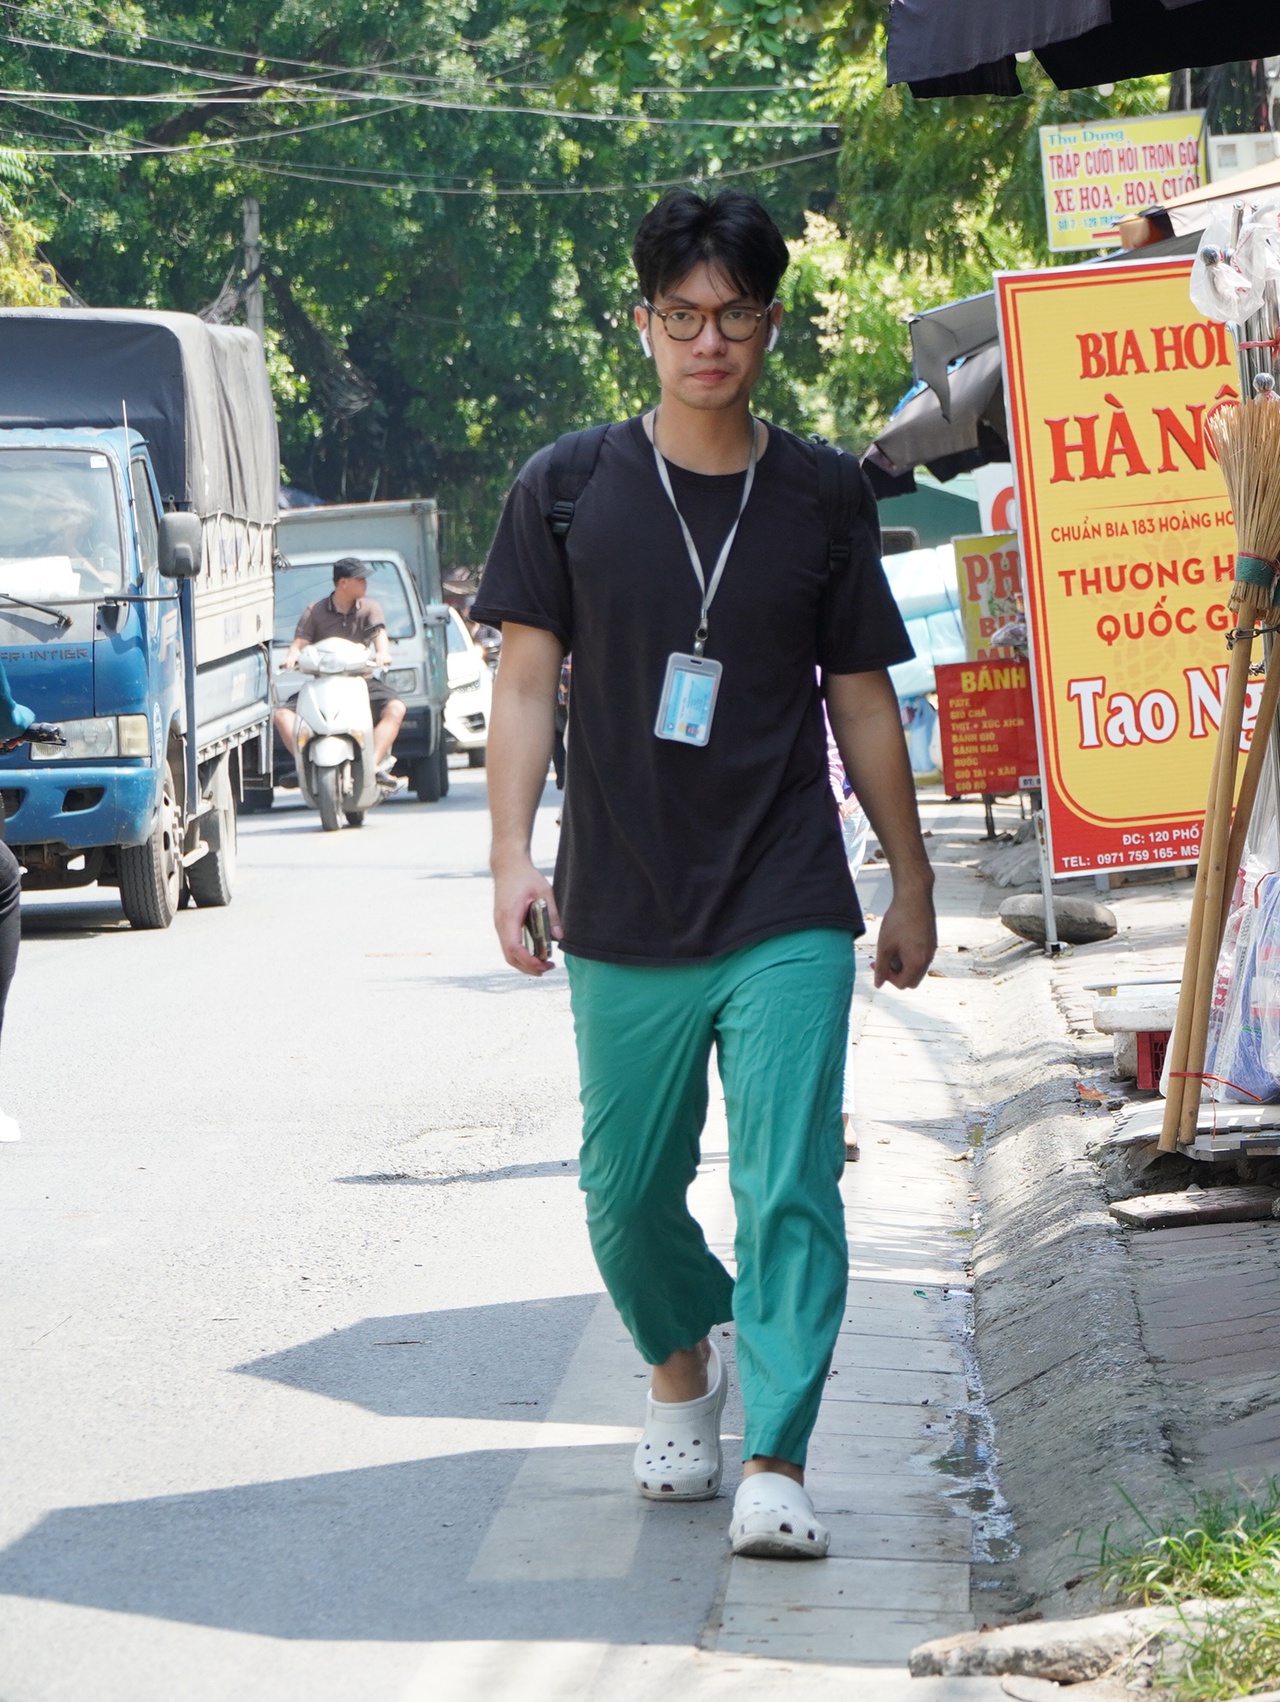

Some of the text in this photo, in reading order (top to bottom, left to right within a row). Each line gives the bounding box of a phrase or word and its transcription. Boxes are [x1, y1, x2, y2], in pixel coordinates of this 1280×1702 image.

[1047, 130, 1125, 146] Thu Dung
[1048, 148, 1081, 180] TRÁP
[1142, 143, 1175, 175] TRỌN
[1053, 188, 1075, 214] XE
[1079, 185, 1113, 210] HOA
[1124, 181, 1159, 206] HOA
[1076, 329, 1148, 380] BIA
[1044, 392, 1152, 485] HÀ
[1051, 515, 1102, 543] CHUẨN
[1105, 520, 1129, 538] BIA
[1132, 517, 1156, 535] 183
[1160, 509, 1212, 533] HOÀNG
[962, 549, 1022, 603] PH
[1058, 556, 1205, 597] THƯƠNG
[1097, 595, 1198, 646] QUỐC
[960, 665, 1027, 693] BÁNH
[1067, 675, 1180, 750] Tao
[1122, 823, 1200, 847] ĐC: 120 PHỐ
[1062, 854, 1091, 869] TEL:
[1097, 851, 1125, 866] 0971
[1129, 847, 1150, 862] 759
[1154, 846, 1178, 860] 165-
